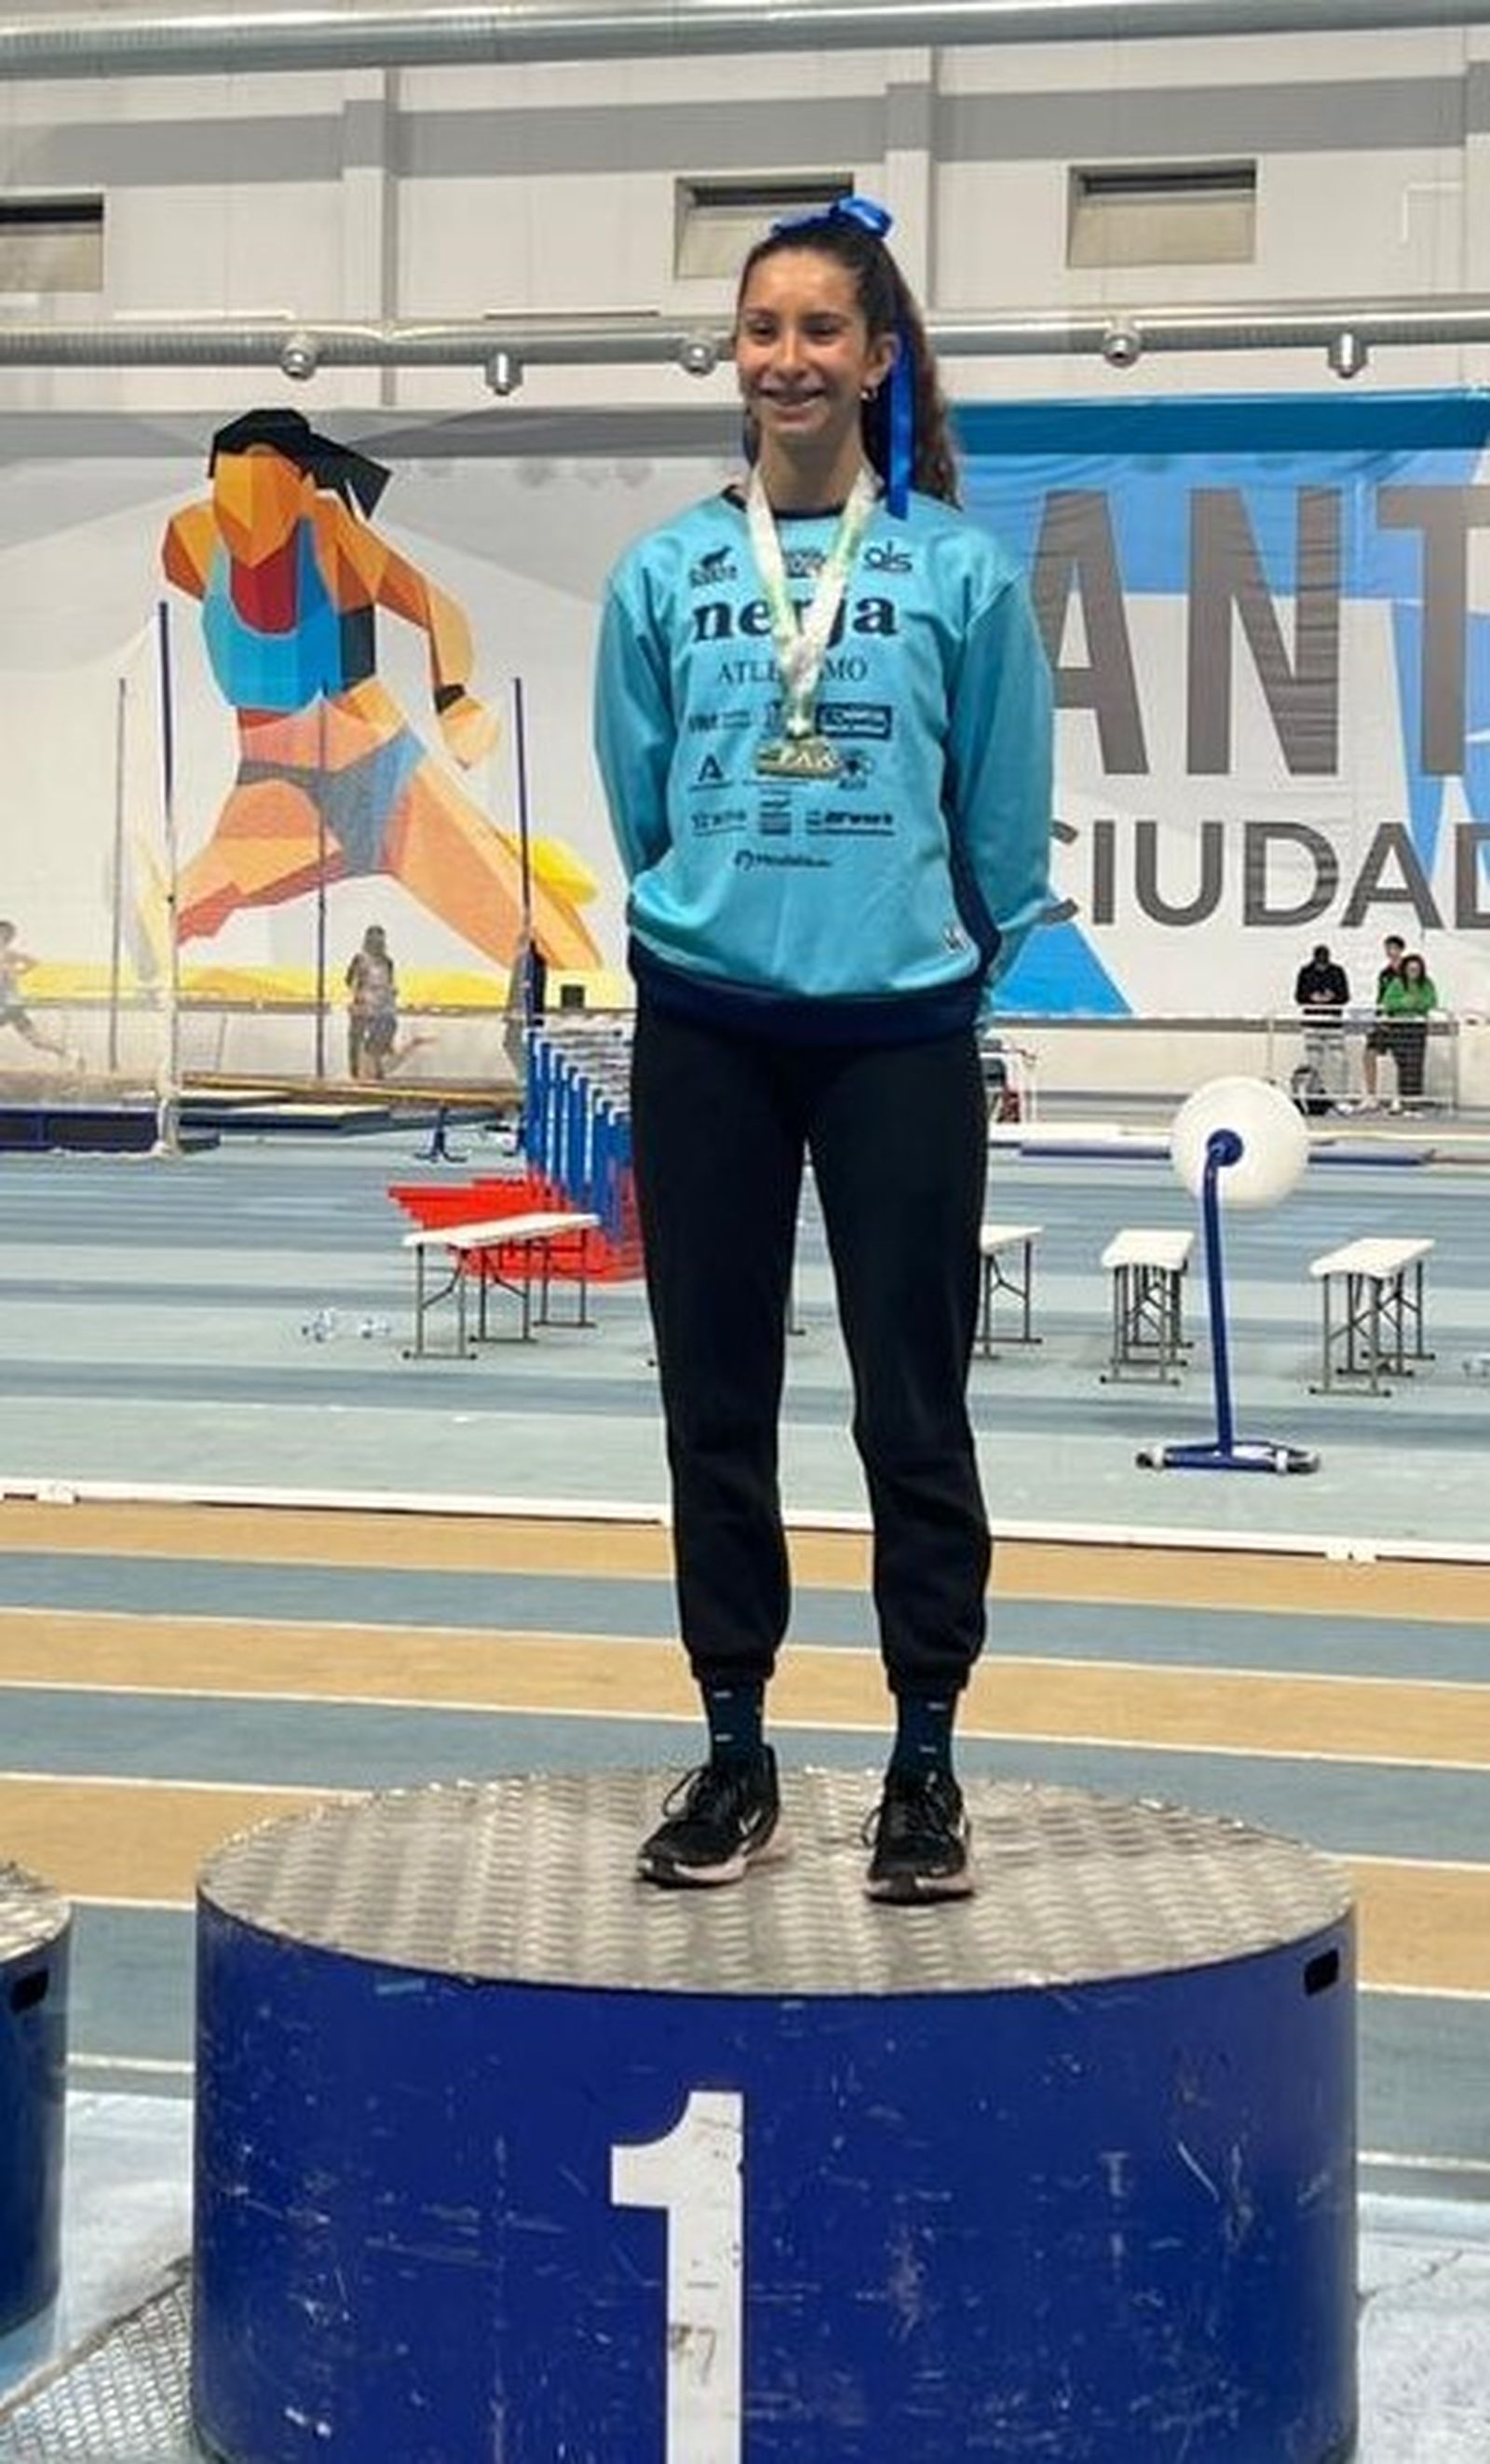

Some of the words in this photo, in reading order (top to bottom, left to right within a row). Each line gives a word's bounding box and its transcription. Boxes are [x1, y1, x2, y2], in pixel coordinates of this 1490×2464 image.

[719, 656, 868, 684] ATLEMO
[1042, 819, 1490, 929] IUDA
[611, 2091, 743, 2464] 1
